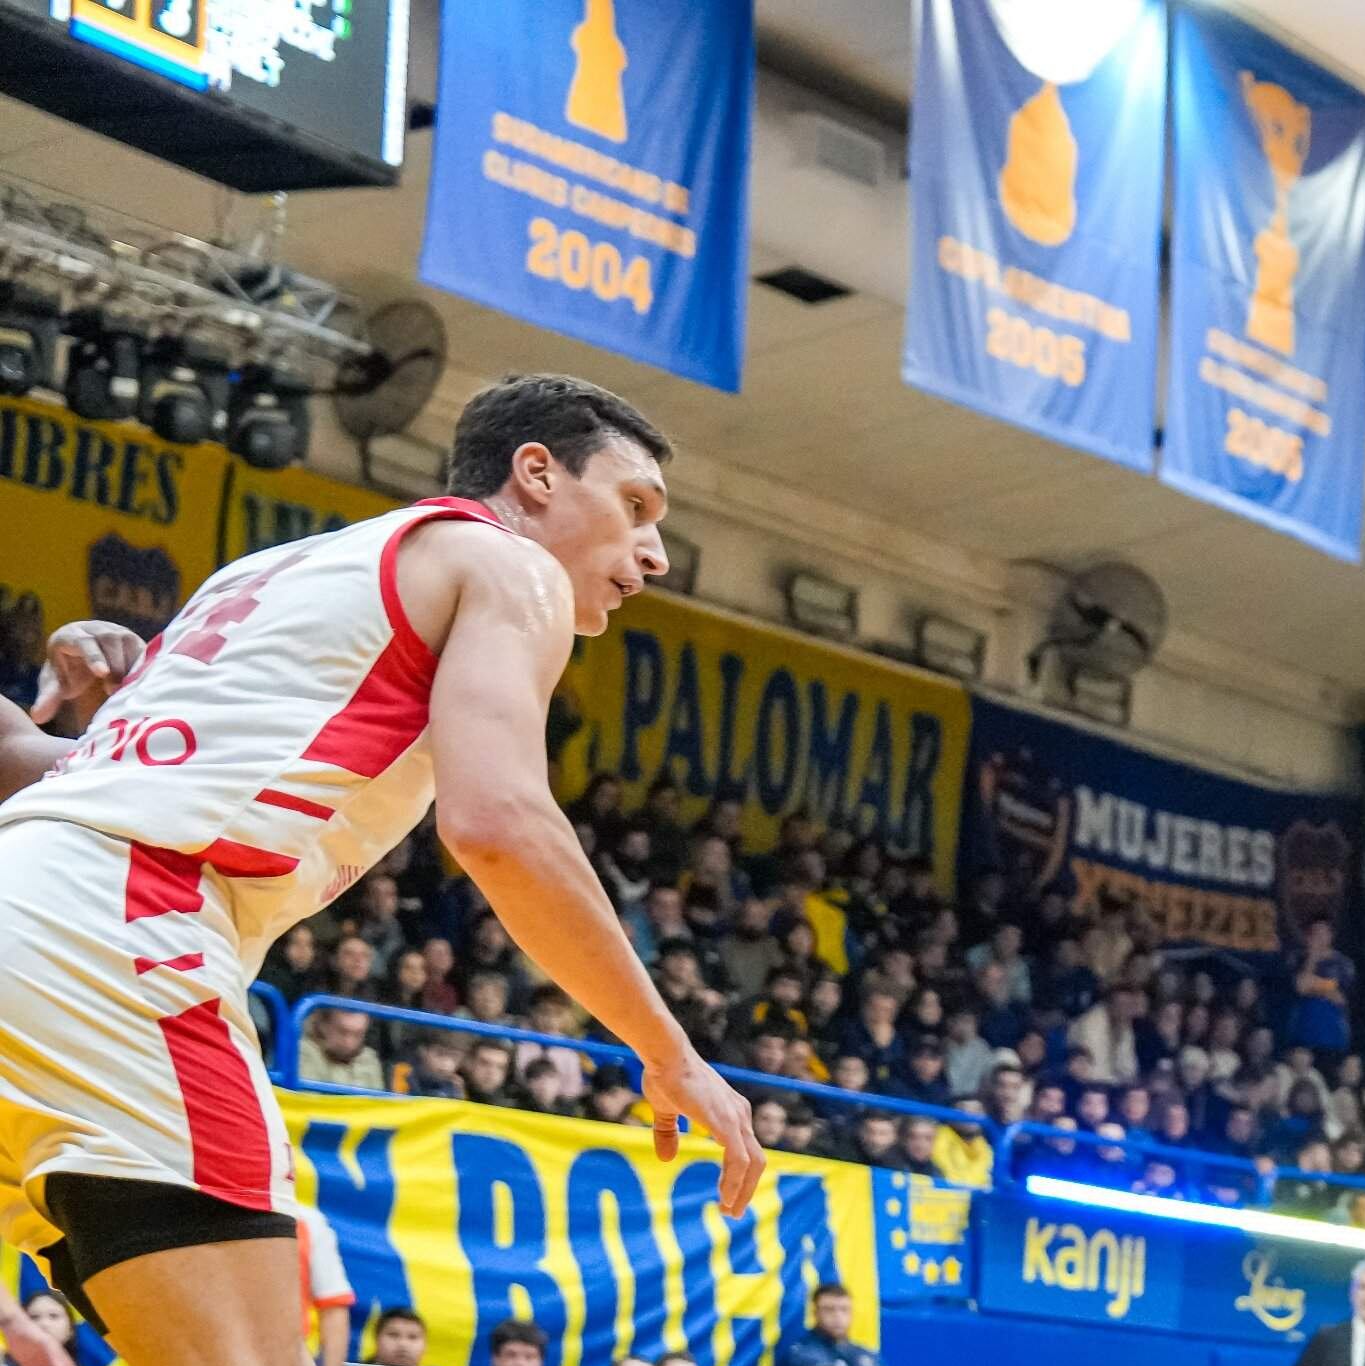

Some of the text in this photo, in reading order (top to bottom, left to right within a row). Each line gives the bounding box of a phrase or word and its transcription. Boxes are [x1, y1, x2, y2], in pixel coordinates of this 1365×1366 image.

[526, 217, 653, 315] 2004
[987, 307, 1085, 388] 2005
[619, 628, 944, 862] PALOMAR
[1073, 783, 1275, 888] MUJERES
[1023, 1217, 1146, 1319] kanji
